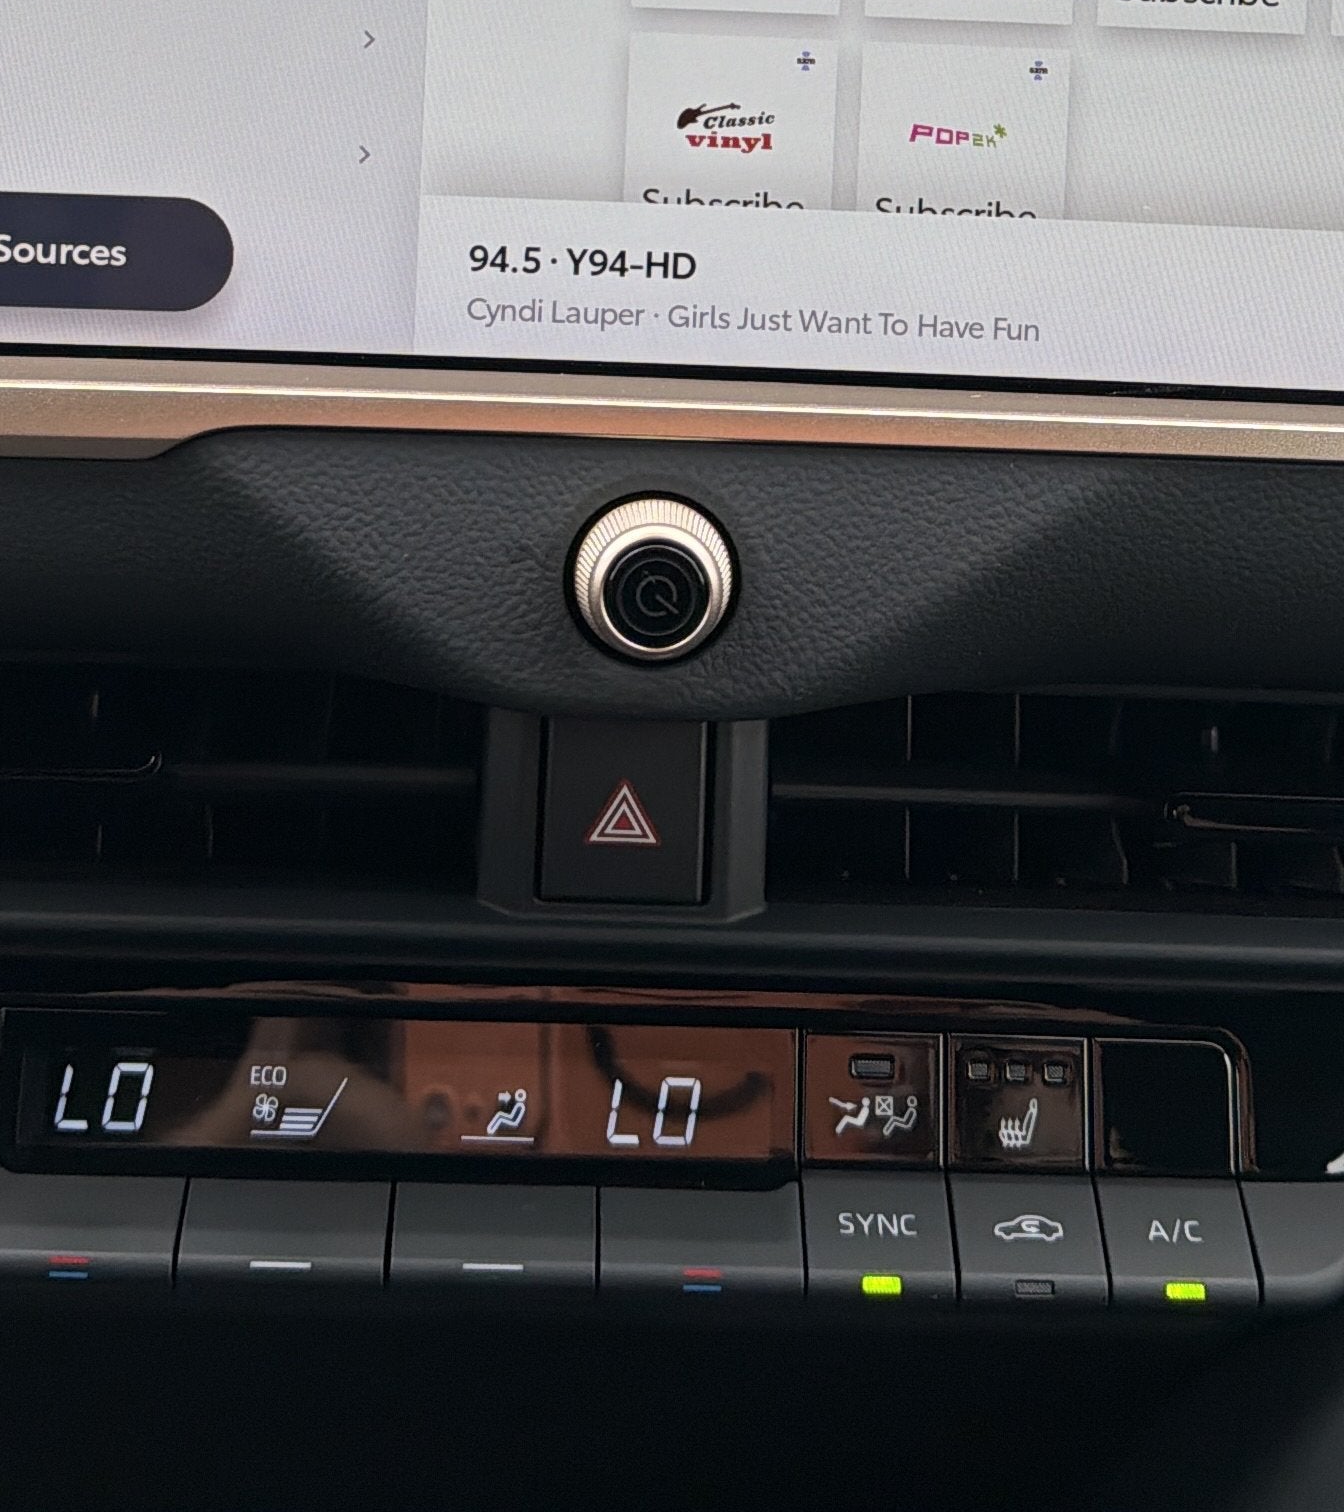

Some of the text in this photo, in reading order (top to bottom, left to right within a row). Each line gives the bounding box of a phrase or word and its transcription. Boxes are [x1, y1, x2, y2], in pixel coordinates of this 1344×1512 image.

[684, 110, 776, 154] Classic vinyl
[469, 245, 697, 280] 94.5 Y94-HD
[467, 297, 1040, 342] Cyndi Lauper Girls Just Want To Have Fun
[250, 1065, 287, 1086] ECO
[54, 1062, 154, 1131] LO
[606, 1076, 701, 1146] LO
[838, 1212, 917, 1237] SYNC
[1148, 1218, 1202, 1243] A/C
